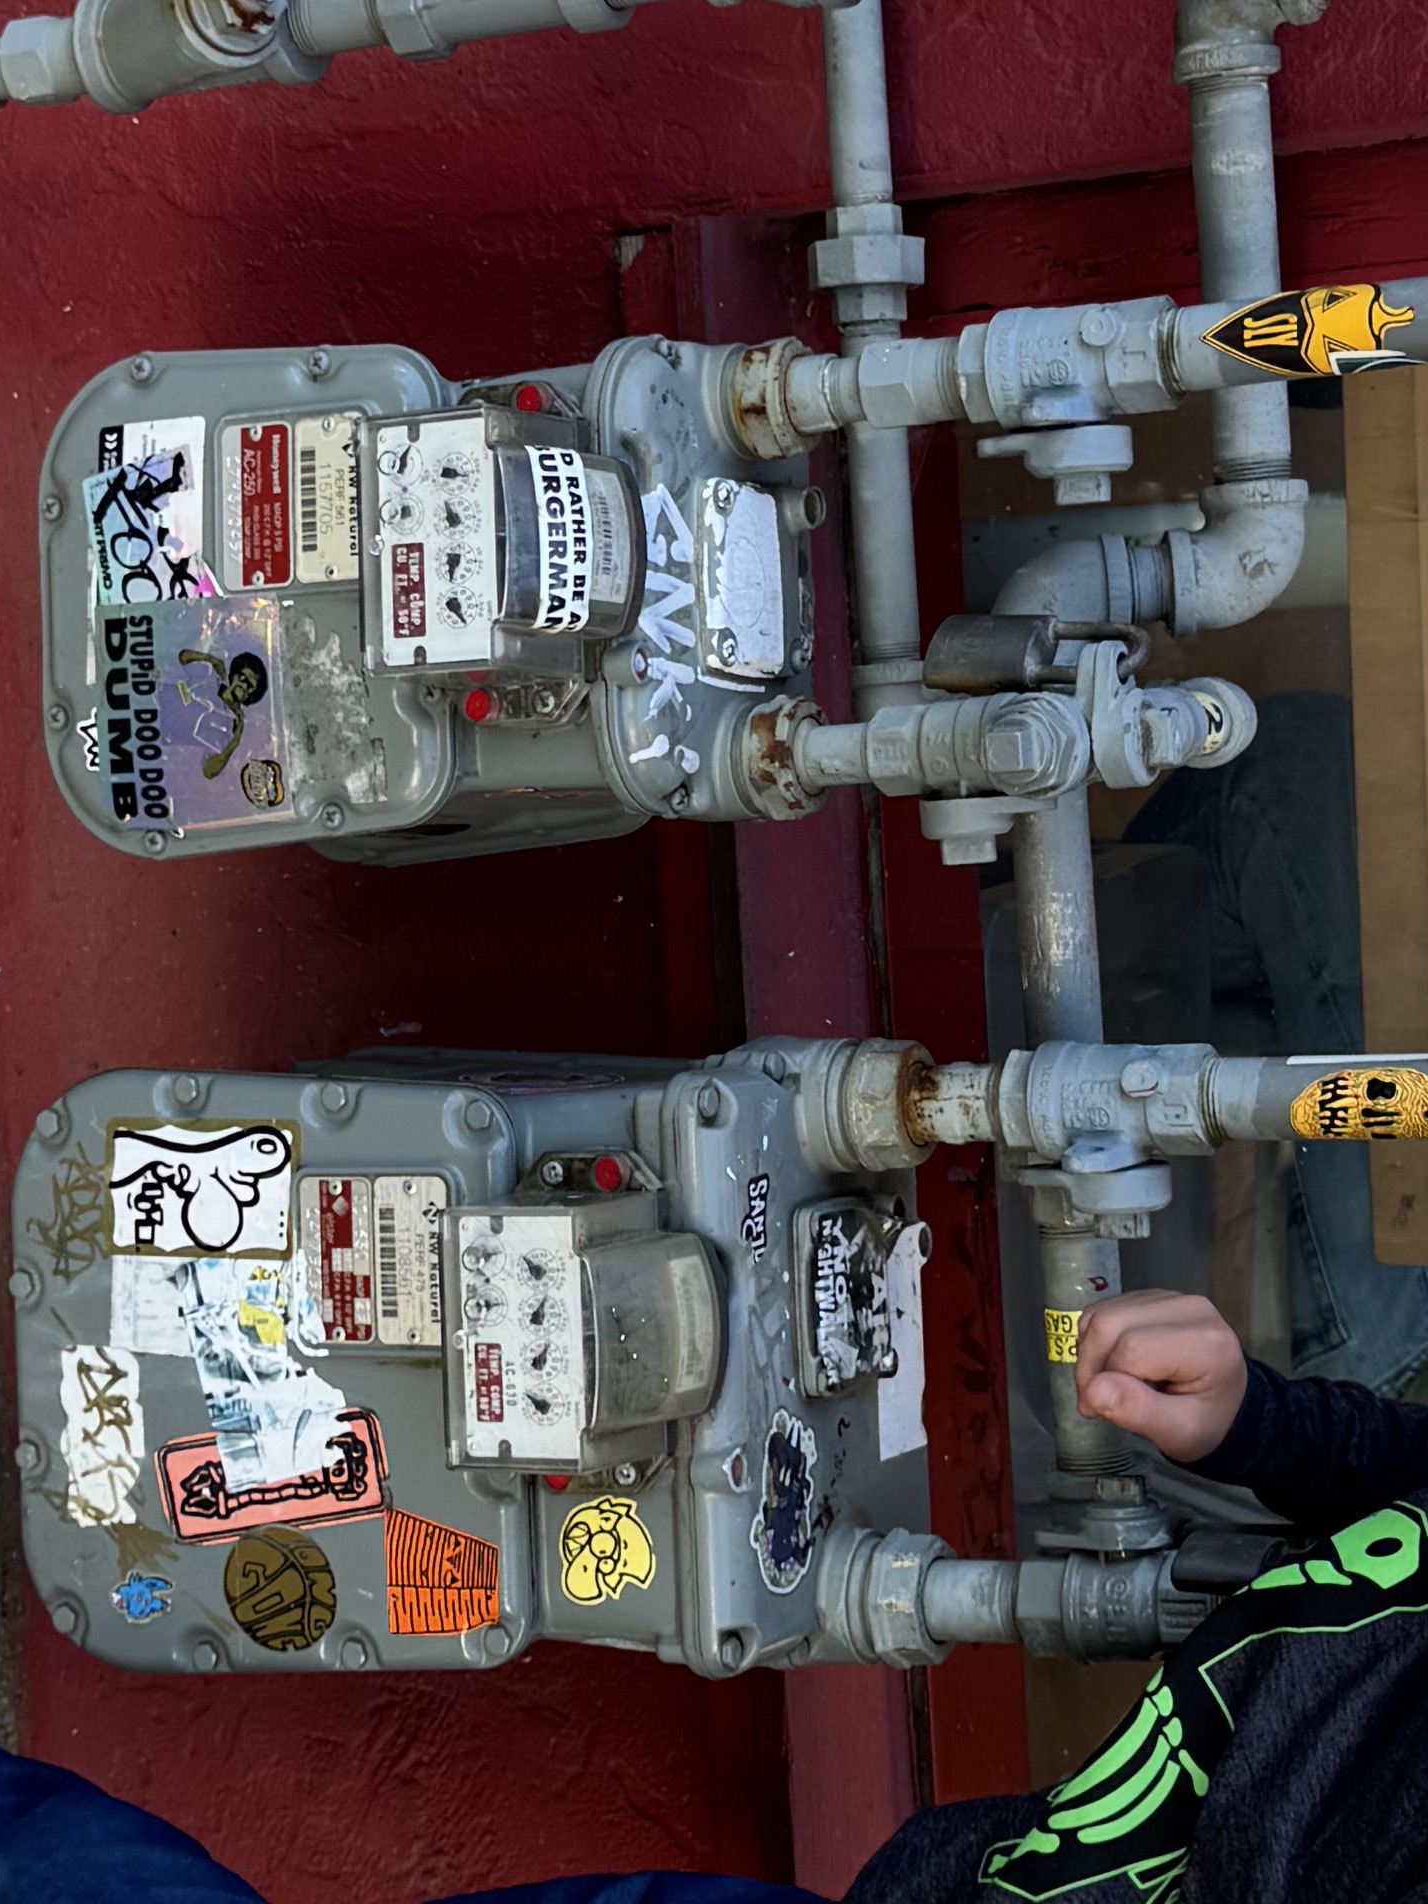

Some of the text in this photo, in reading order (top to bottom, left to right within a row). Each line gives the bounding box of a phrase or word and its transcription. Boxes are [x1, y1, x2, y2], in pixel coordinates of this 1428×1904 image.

[243, 449, 256, 496] AC-250
[270, 434, 281, 494] Honeywell
[319, 463, 333, 535] 1157705
[334, 468, 345, 527] PERF 561
[566, 476, 586, 564] RATHER
[409, 551, 421, 586] TEMP.
[571, 574, 586, 602] BE
[103, 617, 139, 821] DUMB
[134, 709, 165, 762] DOO
[139, 768, 169, 819] DOO
[414, 1233, 425, 1267] PERF
[428, 1231, 441, 1324] NW Natural
